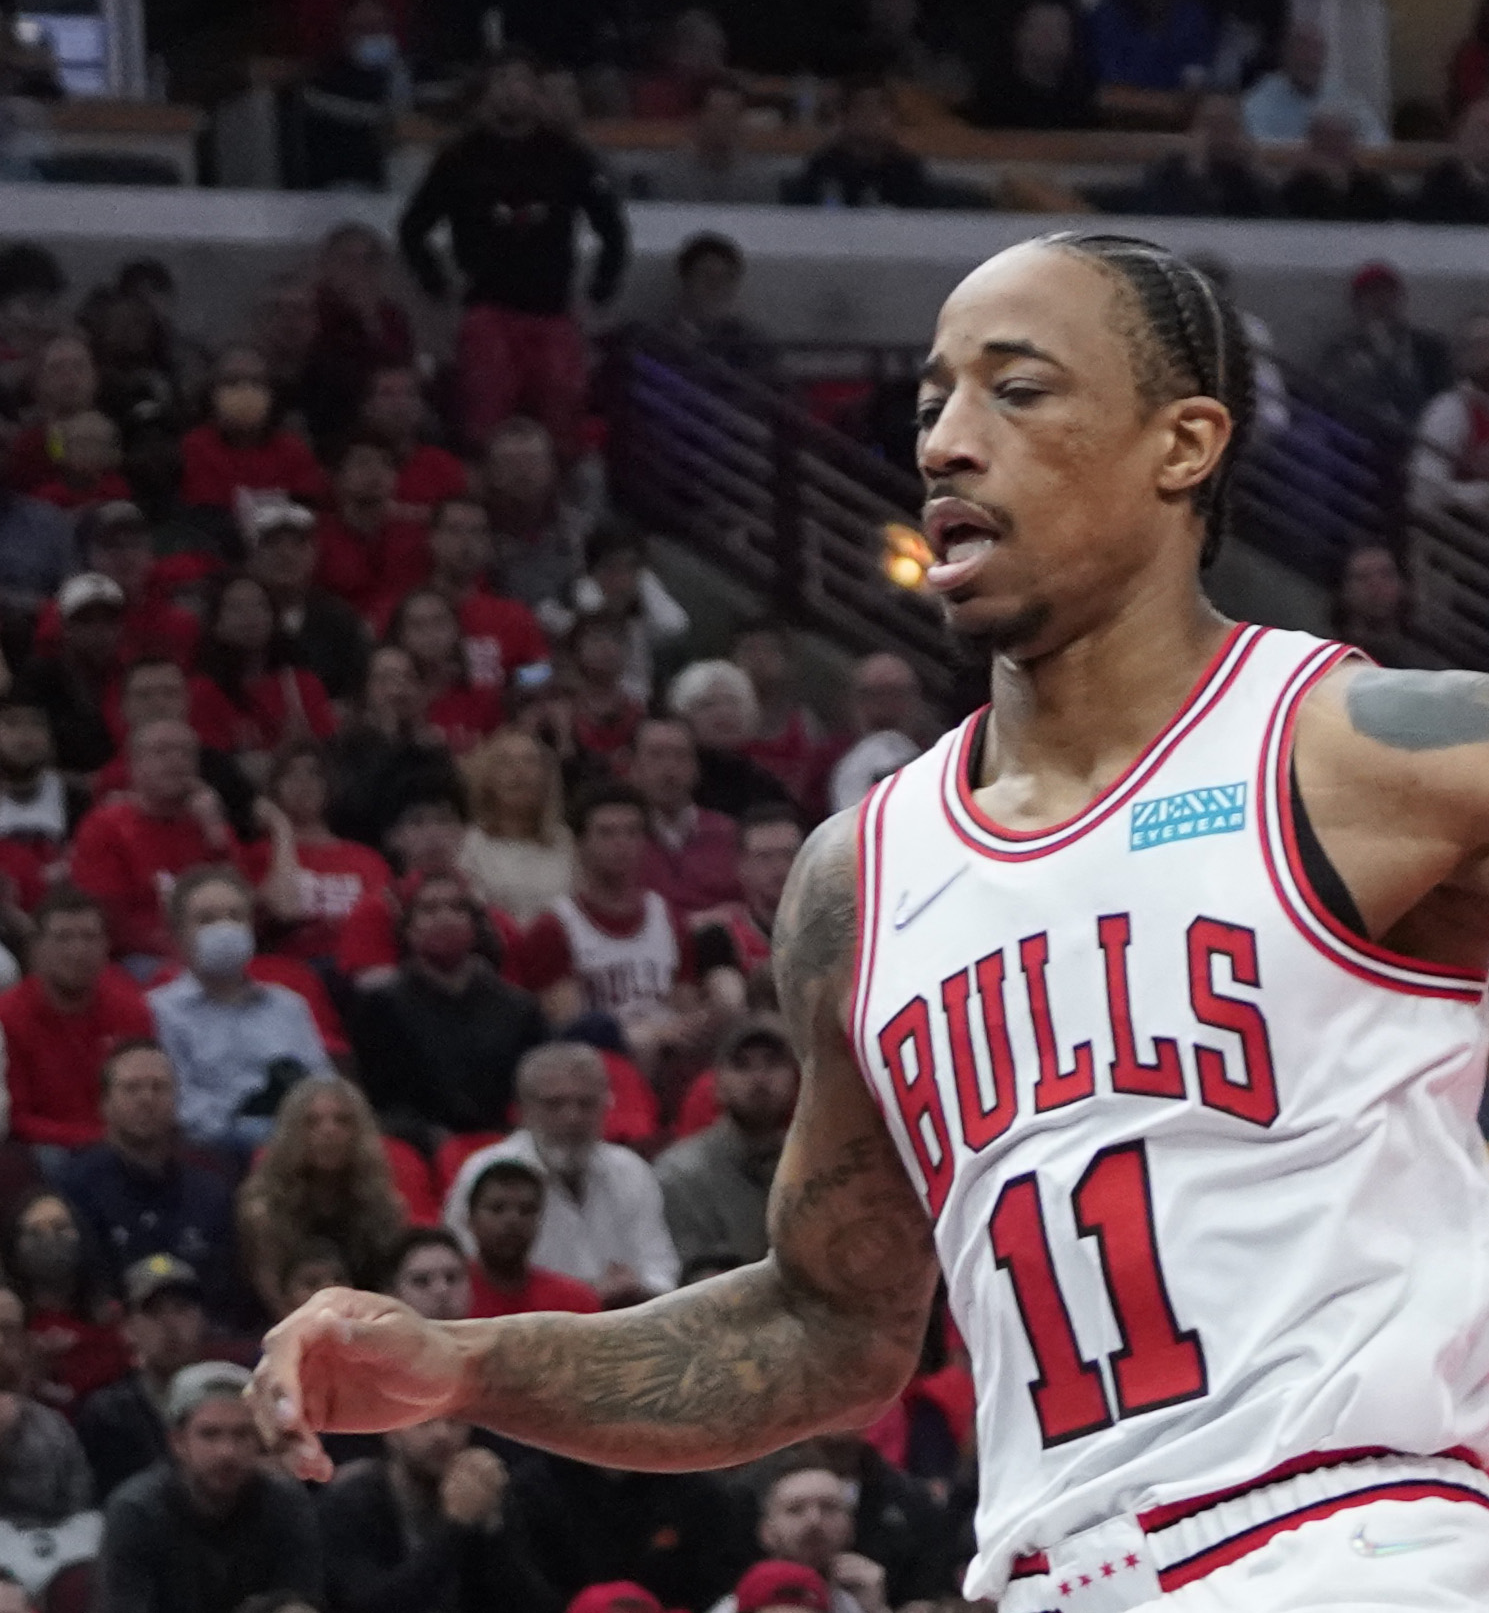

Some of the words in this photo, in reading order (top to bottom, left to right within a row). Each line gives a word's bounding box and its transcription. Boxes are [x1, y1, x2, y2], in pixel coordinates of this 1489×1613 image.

[1131, 812, 1243, 847] EYEWEAR
[1132, 784, 1246, 828] ZENNI
[878, 911, 1280, 1218] BULLS
[989, 1137, 1208, 1450] 11
